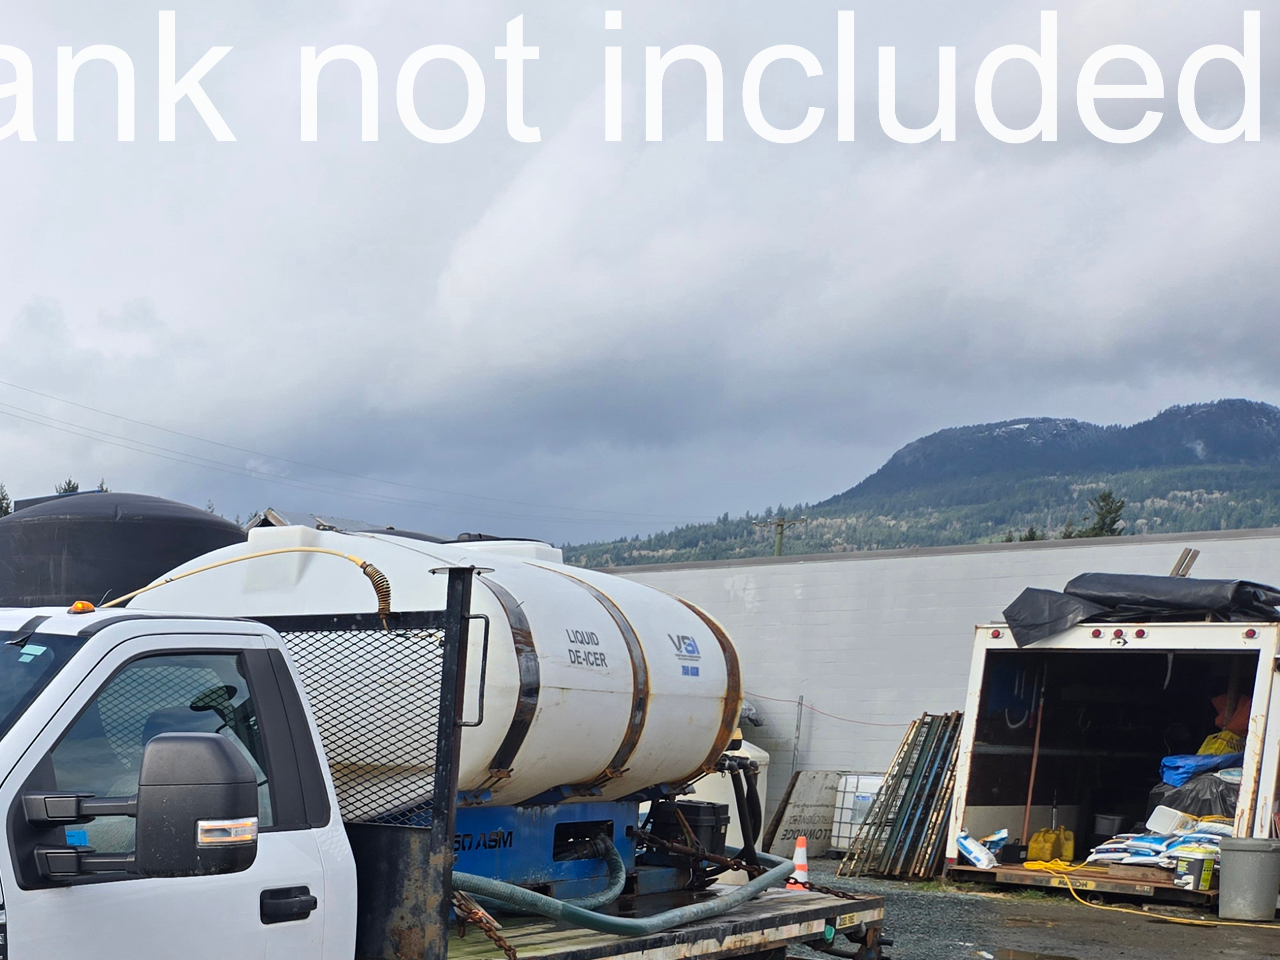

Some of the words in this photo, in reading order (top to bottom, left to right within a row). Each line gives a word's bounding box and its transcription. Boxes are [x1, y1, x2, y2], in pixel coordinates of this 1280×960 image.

[566, 629, 600, 645] LIQUID
[568, 648, 608, 668] DE-ICER
[475, 830, 514, 850] ASM
